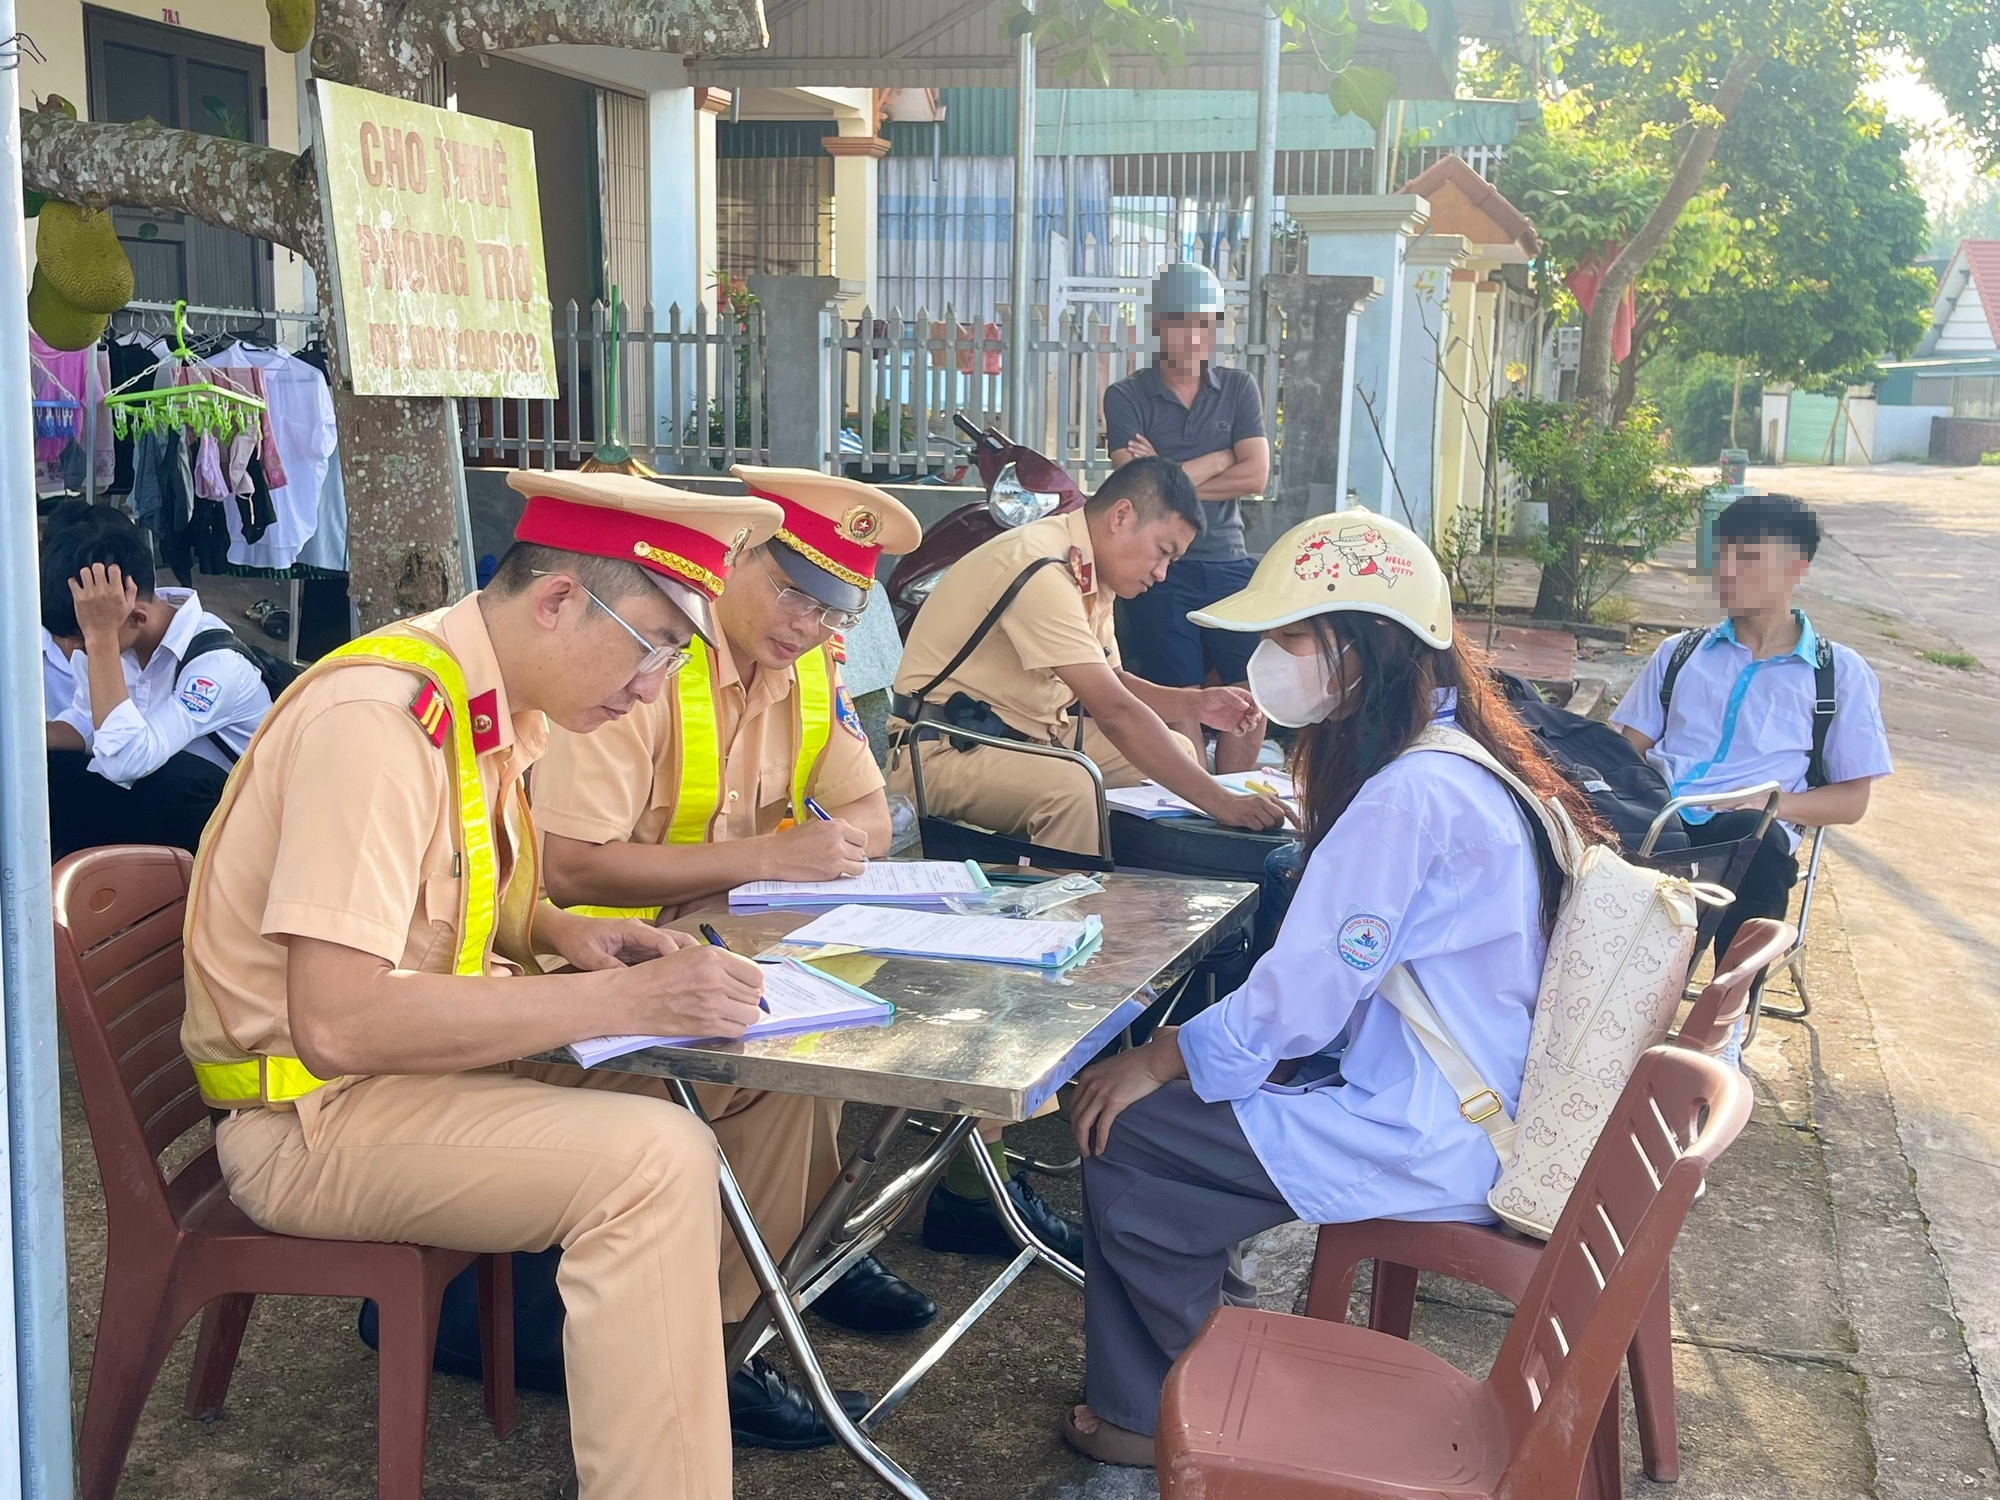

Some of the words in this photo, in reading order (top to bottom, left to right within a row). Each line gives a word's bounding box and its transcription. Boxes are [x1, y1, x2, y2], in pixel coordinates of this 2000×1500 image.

[162, 8, 180, 24] 78.1
[359, 121, 427, 194] CHO
[434, 138, 512, 209] THUÊ
[356, 215, 470, 296] PHÒNG
[476, 242, 532, 314] TRỌ
[1301, 533, 1316, 545] LOVE
[1384, 556, 1412, 567] HELLO
[1390, 566, 1414, 577] KITTY
